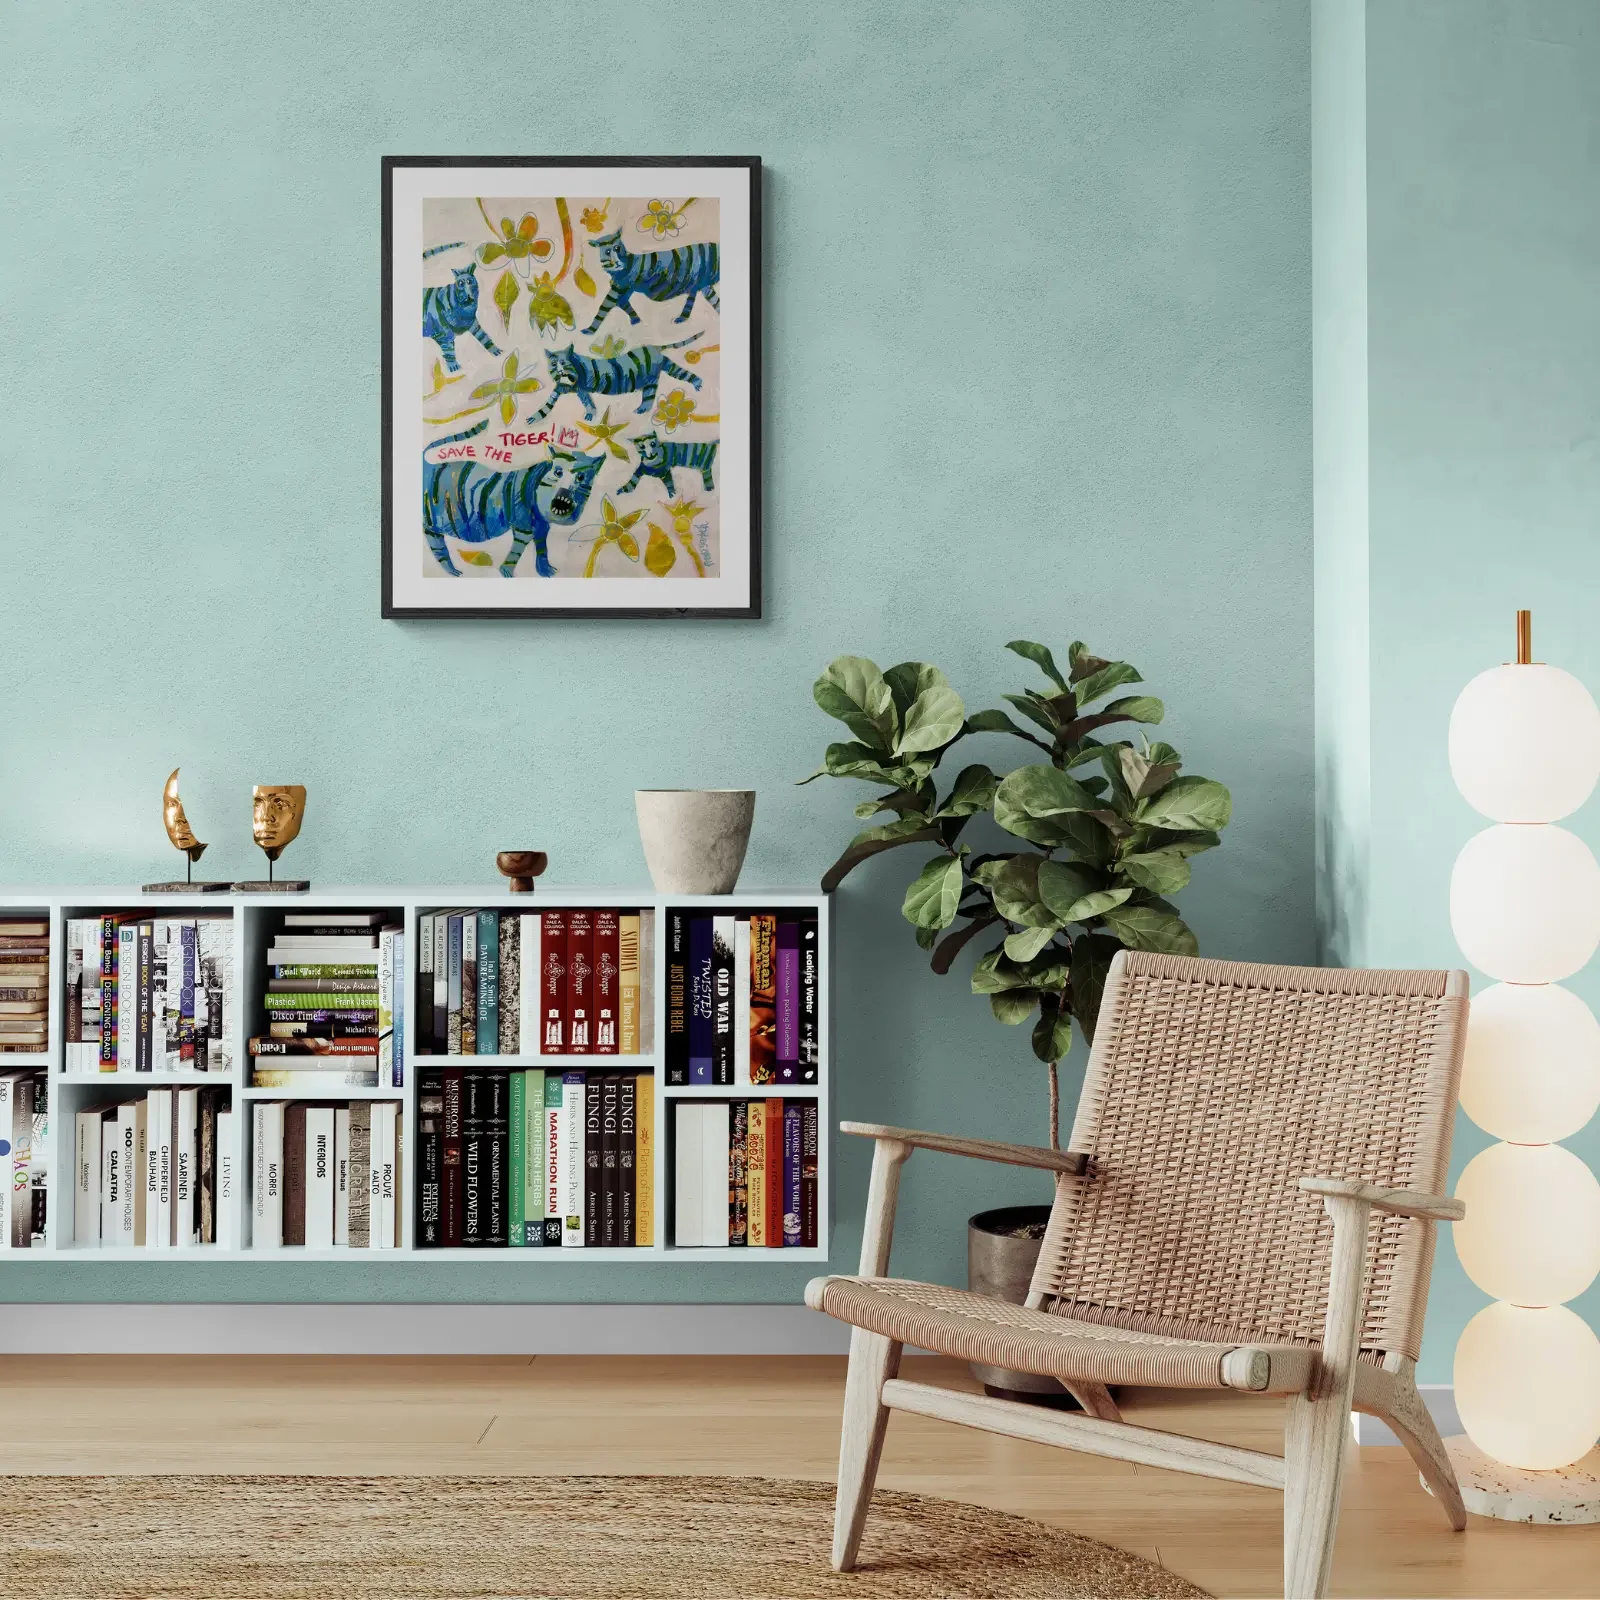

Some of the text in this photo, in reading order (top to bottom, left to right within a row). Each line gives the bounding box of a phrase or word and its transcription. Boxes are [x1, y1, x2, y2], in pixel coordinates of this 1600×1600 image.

[438, 423, 556, 463] SAVE THE TIGER!
[182, 926, 193, 1006] DESIGN BOOK
[280, 968, 321, 976] Small World
[621, 931, 637, 972] SANDMAN
[761, 921, 772, 989] Fireman
[122, 945, 131, 1042] DESIGN BOOK 2014
[142, 988, 147, 997] OF
[332, 982, 351, 992] Design
[671, 964, 683, 1033] JUST BORN REBEL
[691, 976, 700, 993] Ruby
[701, 958, 712, 1018] TWISTED
[717, 968, 728, 1033] OLD WAR
[805, 950, 814, 1013] Leaking Water
[272, 1011, 294, 1020] Disco
[479, 1007, 487, 1020] JOE
[783, 999, 791, 1022] packing
[569, 1120, 578, 1139] AND
[588, 1084, 599, 1134] FUNGI
[604, 1084, 616, 1134] FUNGI
[622, 1084, 633, 1134] FUNGI
[733, 1103, 745, 1140] Whiskey
[13, 1137, 31, 1191] CHAOS
[317, 1135, 325, 1178] INTERIORS
[427, 1163, 431, 1171] OF
[468, 1142, 477, 1174] WILD
[534, 1088, 542, 1206] THE NORTHERN HERBS
[569, 1141, 578, 1179] HEALING
[792, 1119, 800, 1212] FLAVORS OF THE WORLD
[110, 1150, 118, 1202] CALATRA
[179, 1153, 187, 1200] SAARINEN
[383, 1164, 393, 1198] PROUVÉ
[569, 1182, 578, 1212] PLANTS
[640, 1149, 649, 1242] Plants of the Future
[124, 1204, 132, 1231] HOUSES
[422, 1184, 431, 1222] ETHICS
[468, 1176, 477, 1234] FLOWERS
